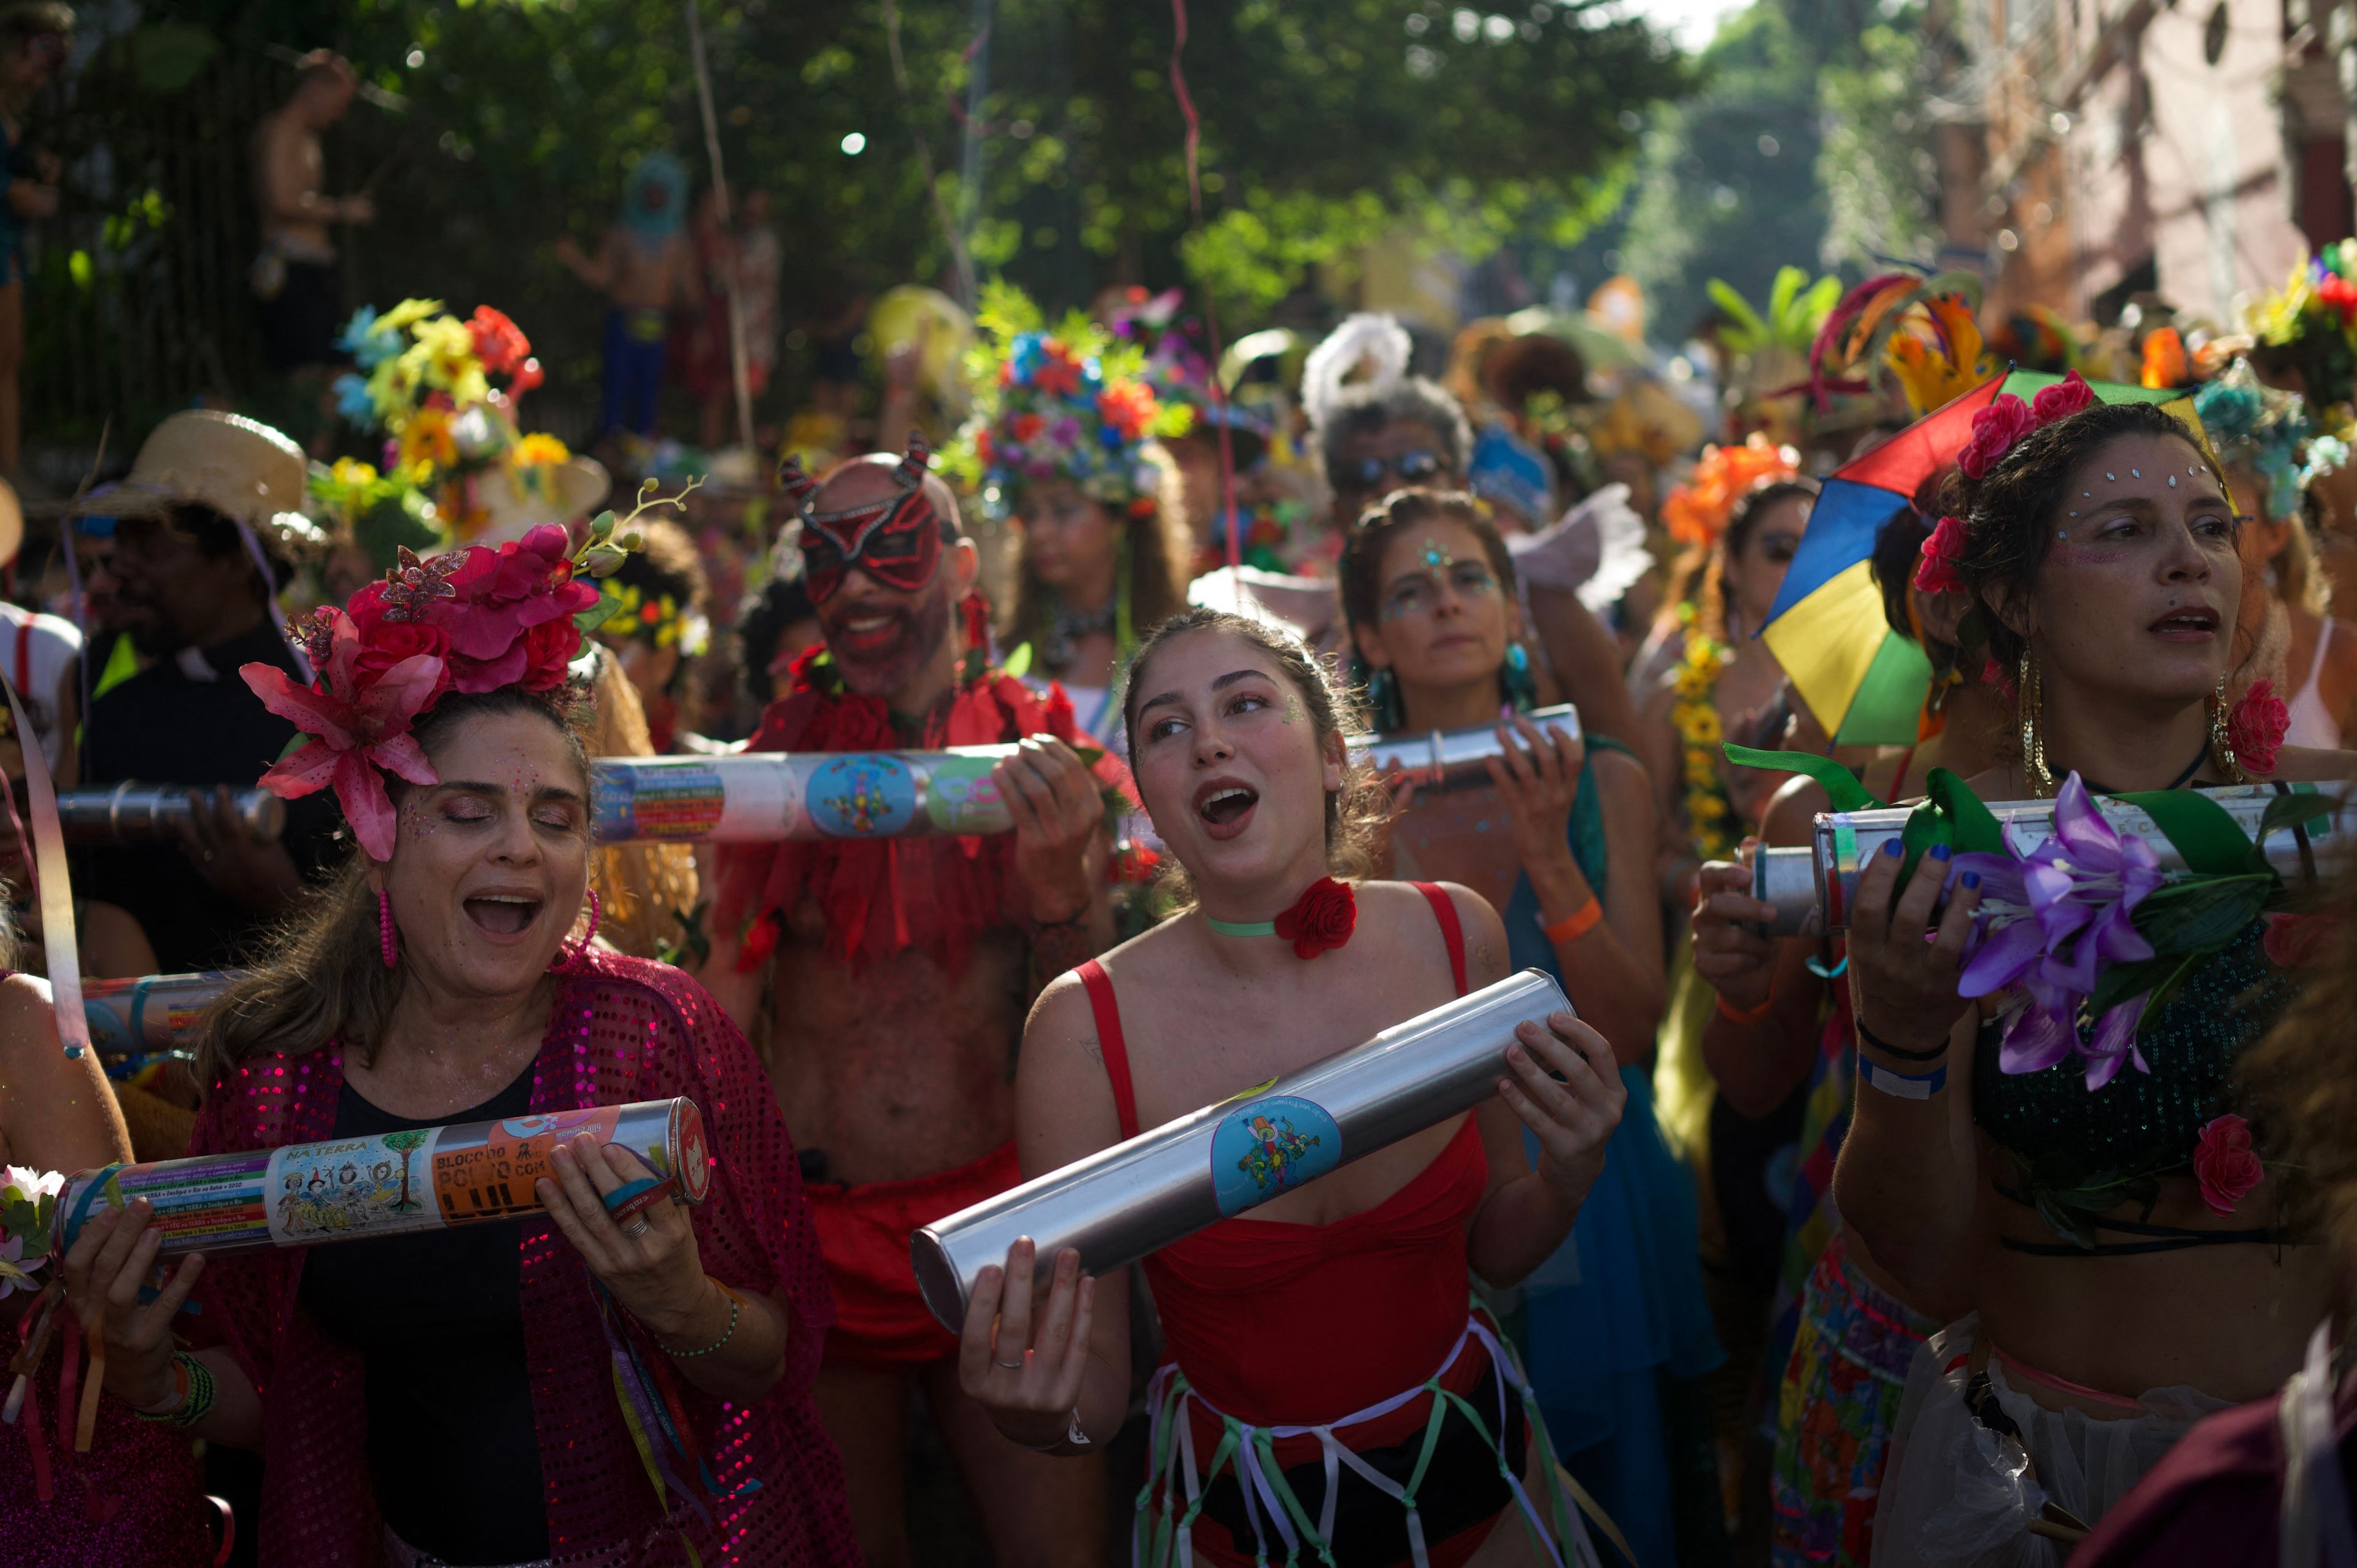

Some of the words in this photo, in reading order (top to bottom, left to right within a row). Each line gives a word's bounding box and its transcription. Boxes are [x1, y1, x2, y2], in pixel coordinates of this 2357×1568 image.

[285, 1149, 310, 1161] NA
[314, 1141, 368, 1157] TERRA
[436, 1151, 484, 1169] BLOCO
[486, 1147, 506, 1160] DO
[515, 1161, 546, 1177] COM
[641, 1377, 662, 1414] Carnaval
[659, 1415, 673, 1435] 2020
